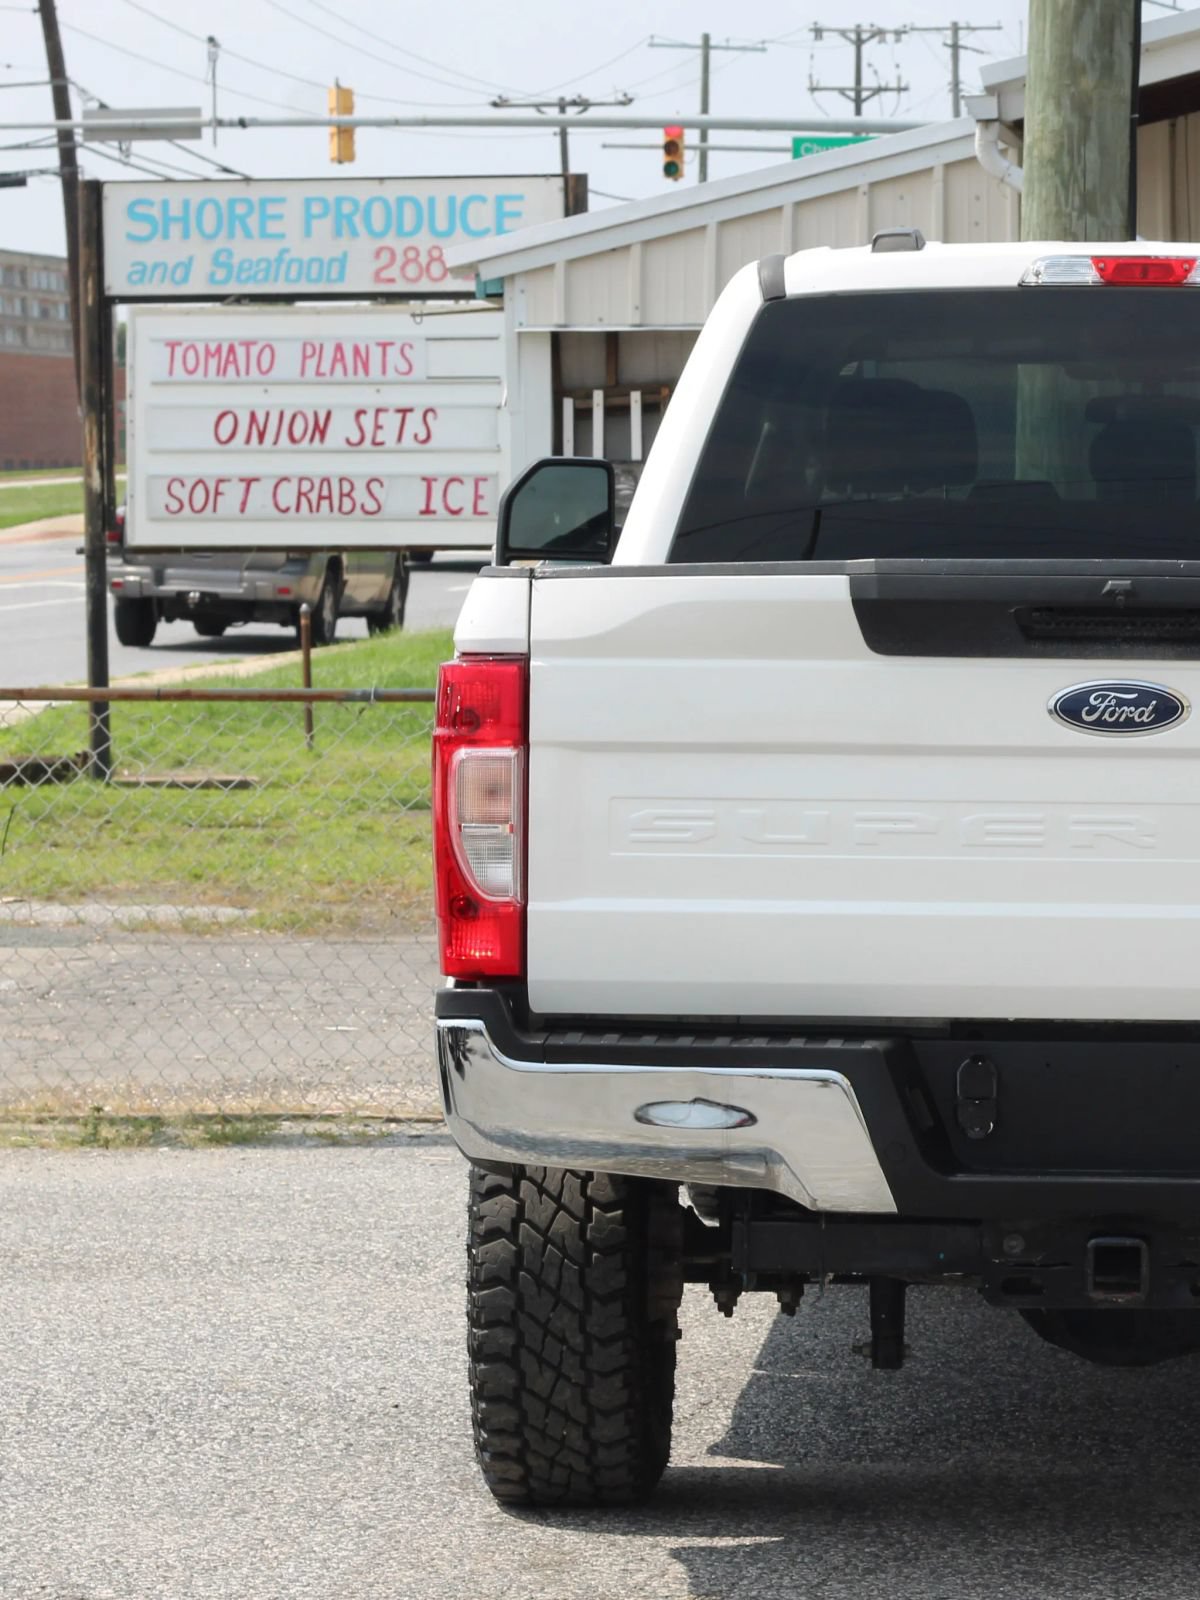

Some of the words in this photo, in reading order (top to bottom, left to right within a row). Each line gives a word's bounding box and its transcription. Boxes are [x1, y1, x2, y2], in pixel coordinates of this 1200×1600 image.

[126, 196, 287, 243] SHORE
[303, 194, 525, 240] PRODUCE
[127, 256, 193, 286] and
[207, 246, 348, 286] Seafood
[373, 245, 476, 285] 288
[165, 340, 276, 377] TOMATO
[300, 340, 414, 378] PLANTS
[213, 408, 332, 446] ONION
[345, 407, 438, 447] SETS
[165, 476, 260, 515] SOFT
[271, 475, 384, 516] CRABS
[419, 475, 489, 517] ICE
[1081, 691, 1157, 722] Ford
[628, 808, 1158, 850] SUPER
